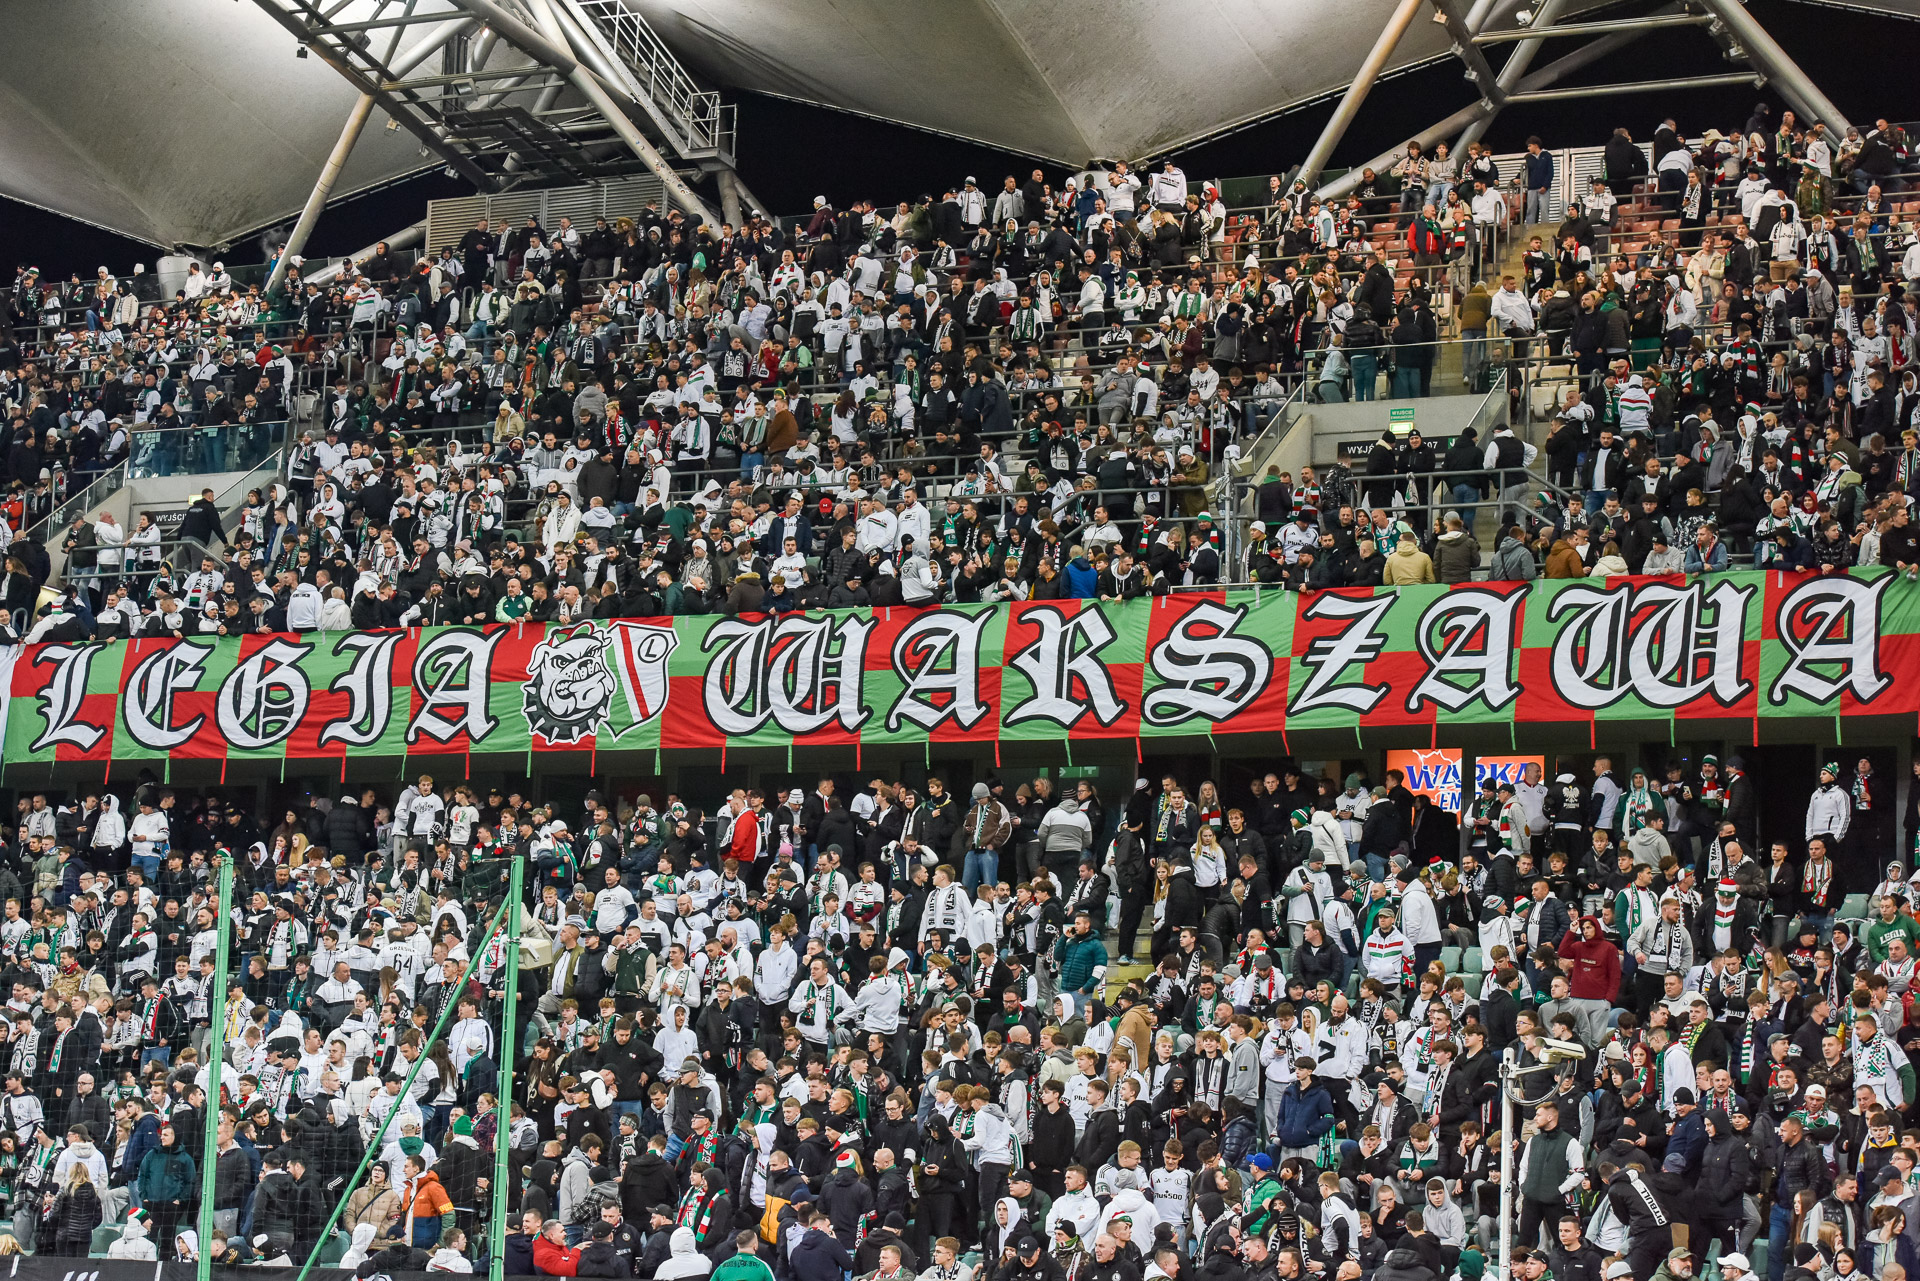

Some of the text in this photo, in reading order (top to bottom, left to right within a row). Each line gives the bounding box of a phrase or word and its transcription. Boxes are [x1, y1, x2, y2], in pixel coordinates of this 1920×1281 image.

[1347, 443, 1375, 454] WYJŚ
[156, 513, 187, 523] WYJŚCI
[28, 569, 1901, 754] LEGIA WARSZAWA
[1880, 929, 1907, 945] LEGIA
[393, 953, 413, 976] 64
[1640, 1187, 1666, 1225] PITBULL
